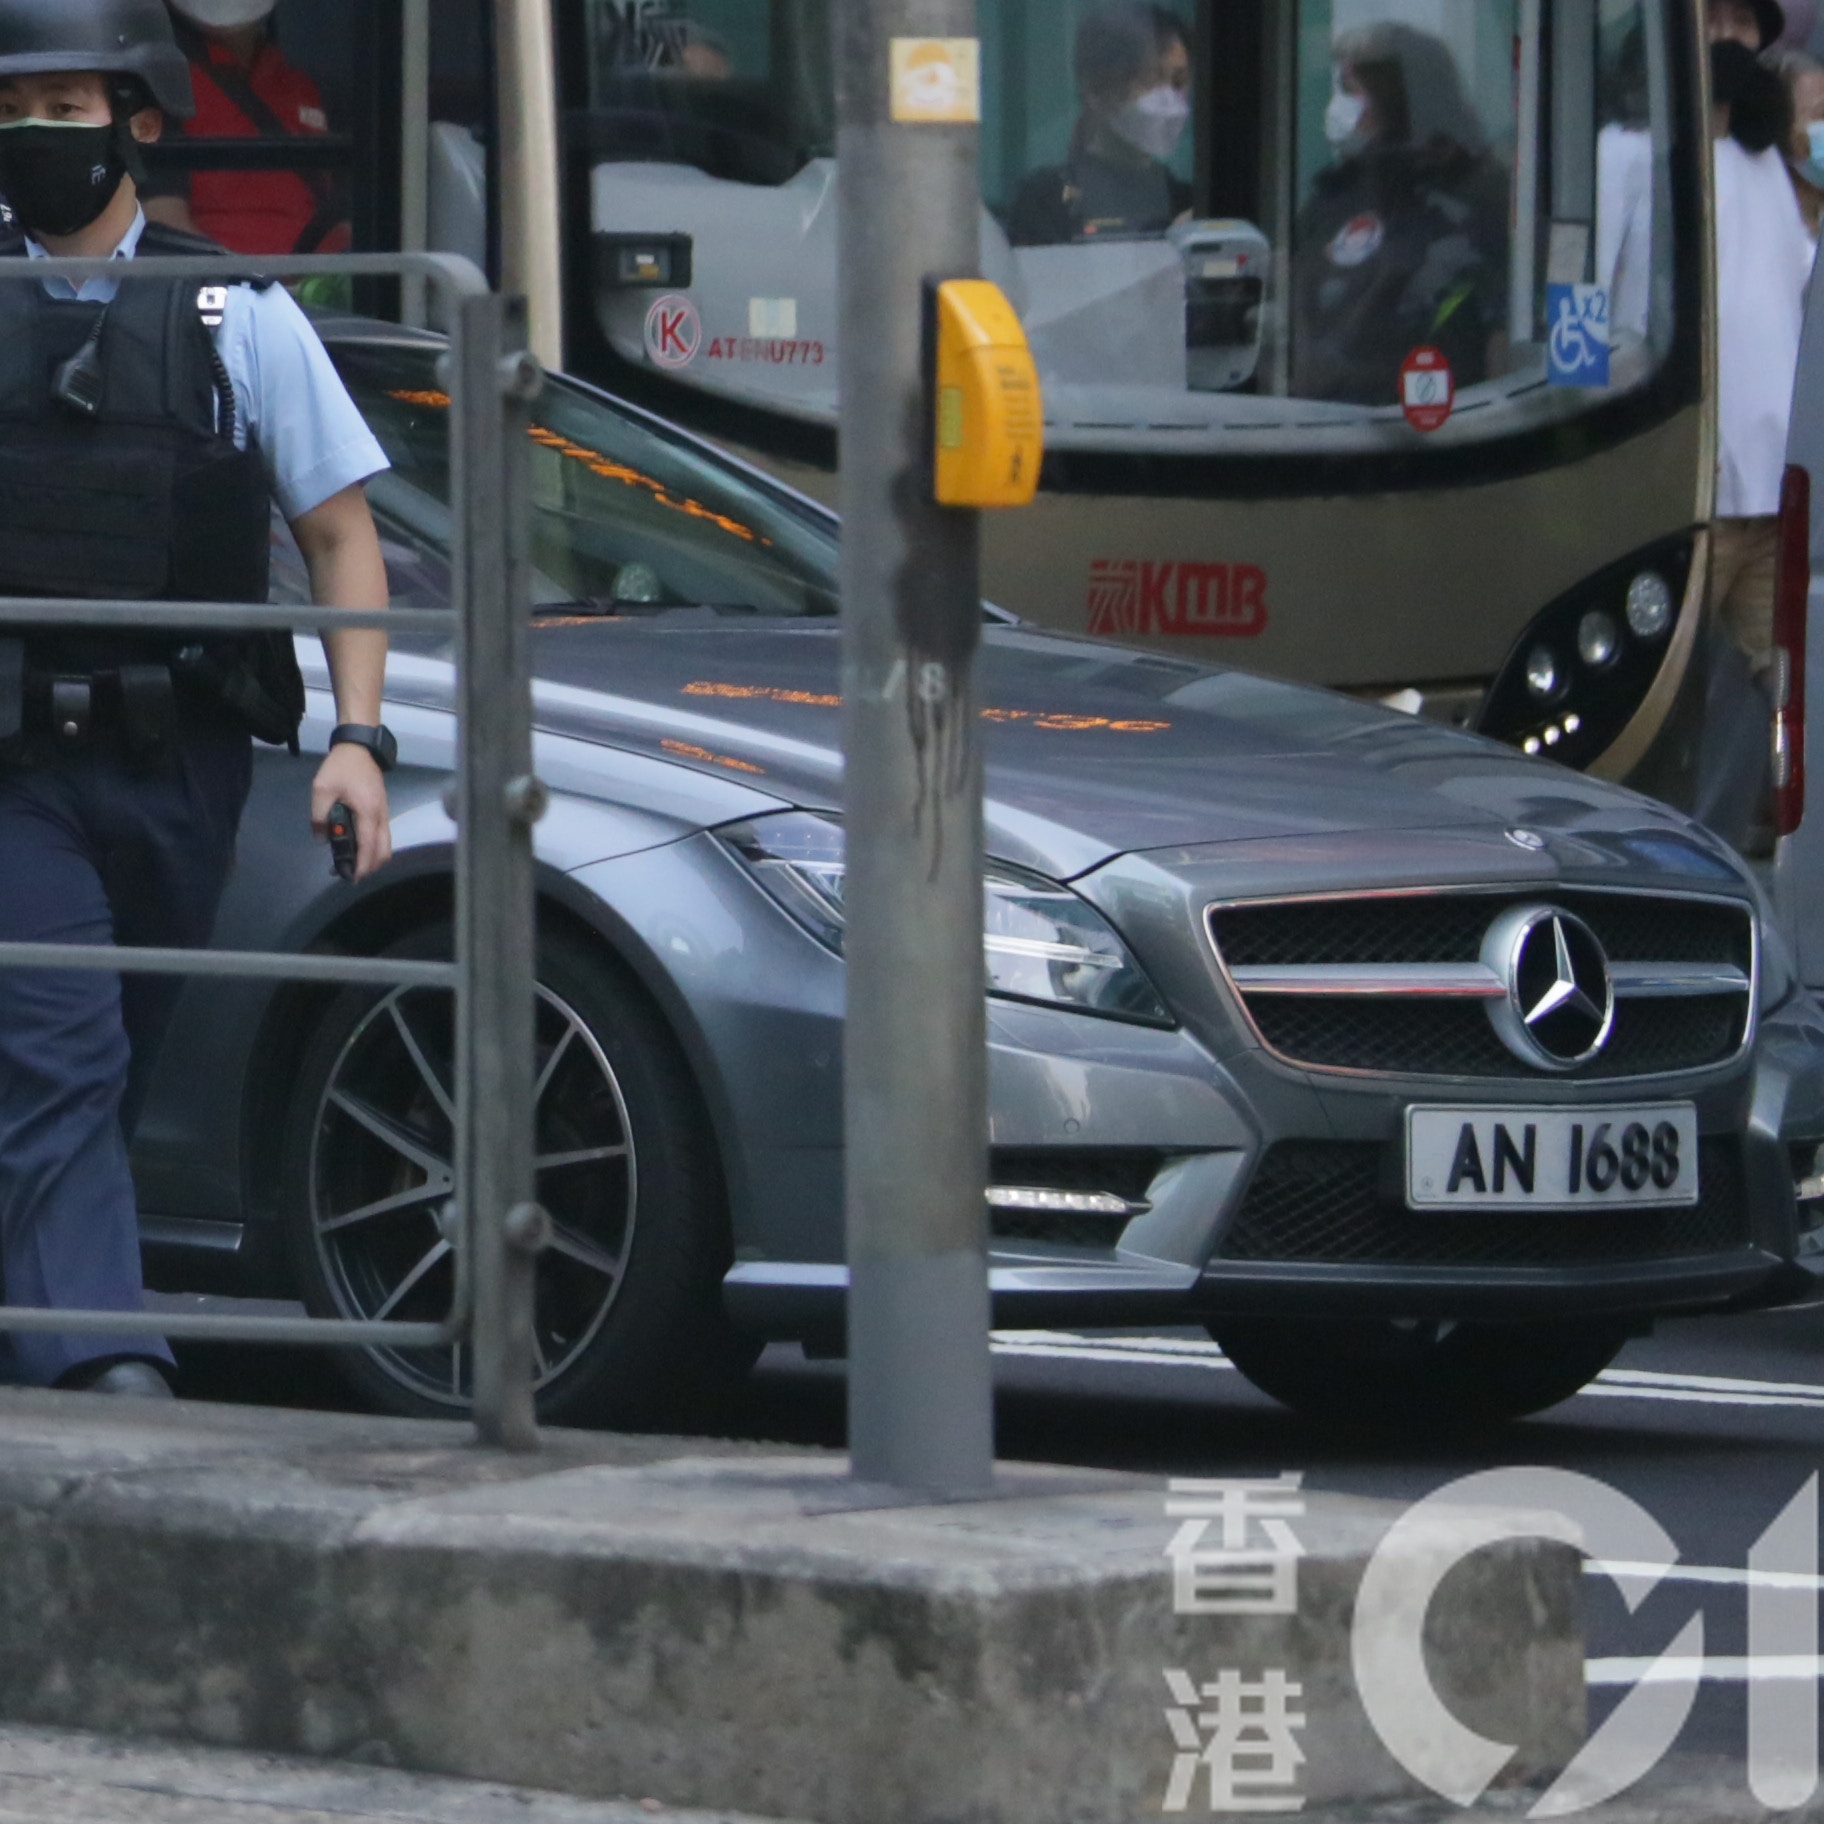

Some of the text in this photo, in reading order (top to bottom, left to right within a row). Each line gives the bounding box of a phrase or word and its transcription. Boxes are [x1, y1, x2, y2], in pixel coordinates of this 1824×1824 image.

[1139, 561, 1268, 636] KMB
[1445, 1121, 1682, 1195] AN 1688
